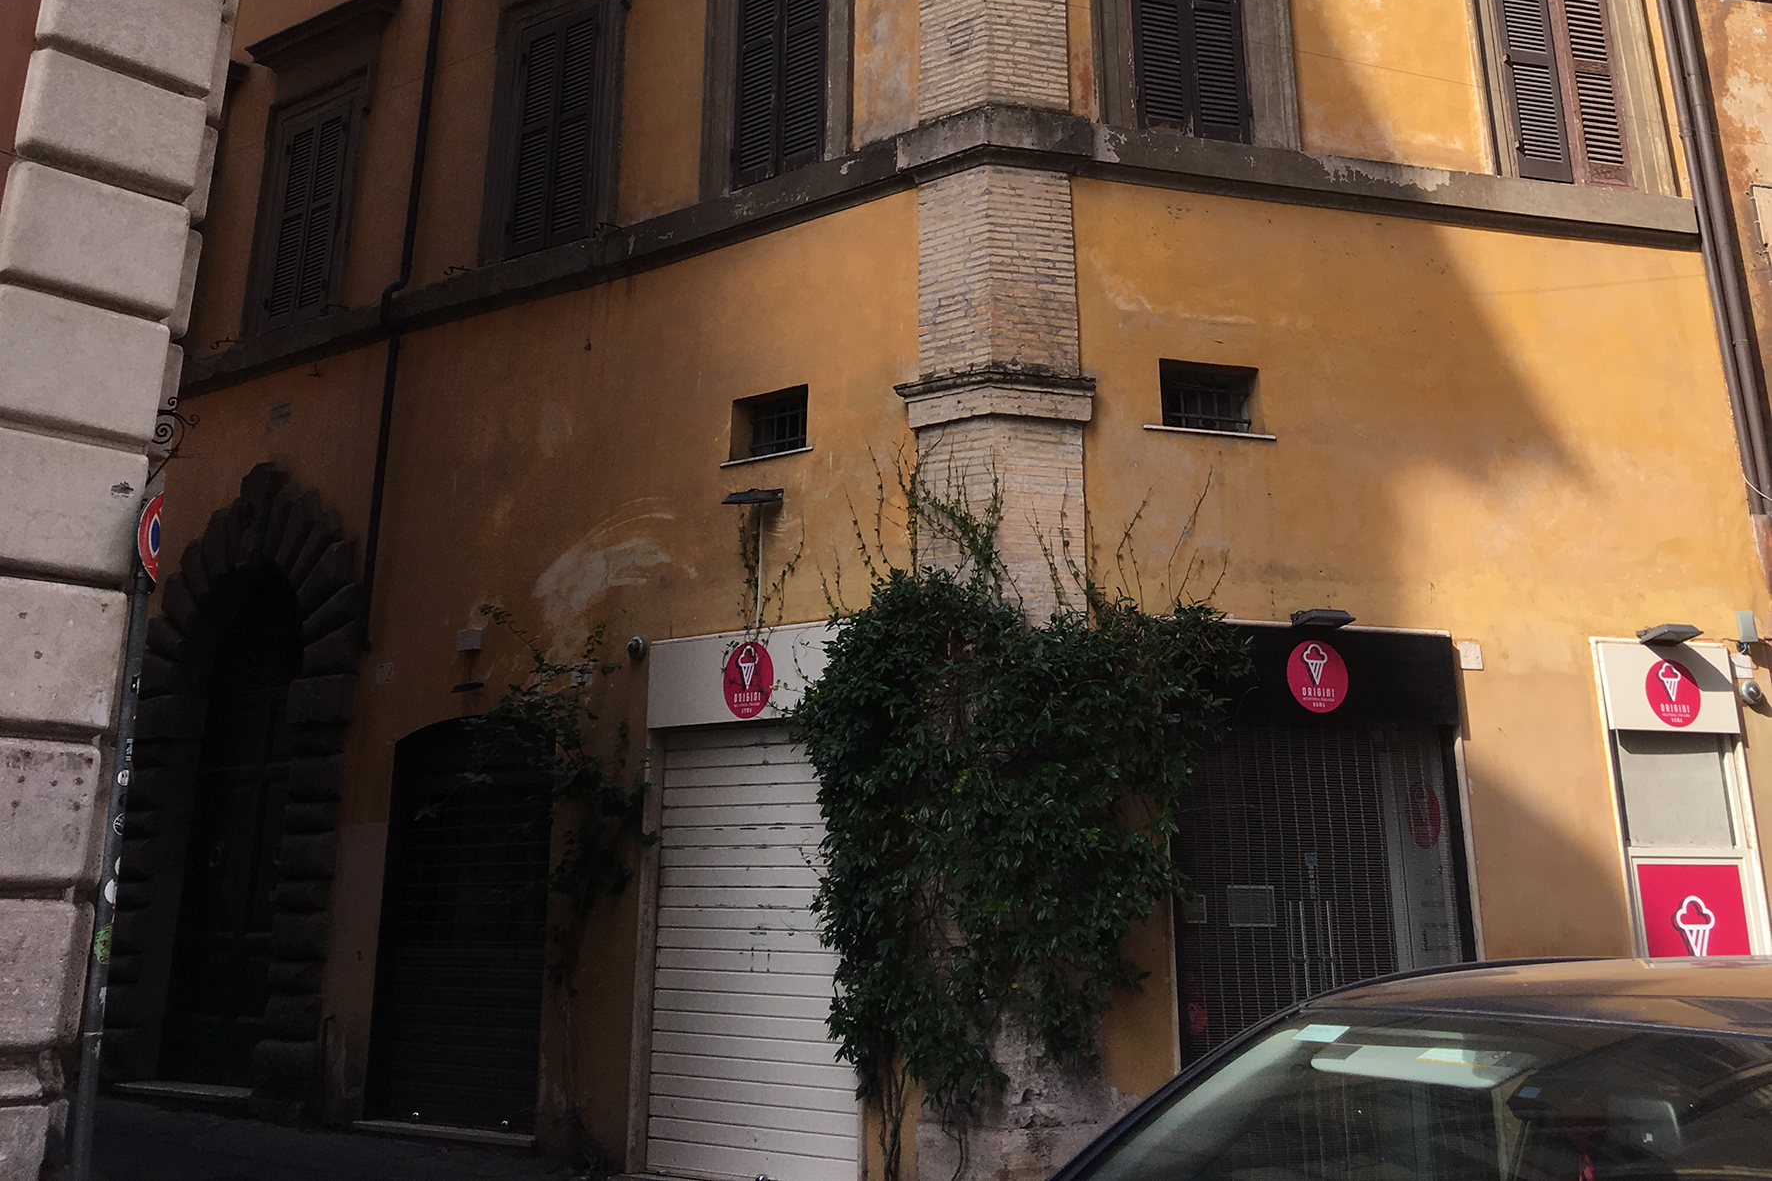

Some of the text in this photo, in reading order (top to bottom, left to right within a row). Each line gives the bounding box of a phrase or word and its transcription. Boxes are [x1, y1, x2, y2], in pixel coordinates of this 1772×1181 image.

[733, 692, 761, 703] ORIGINI
[1302, 687, 1335, 698] ORIGINI
[1660, 703, 1690, 713] ORIGINI
